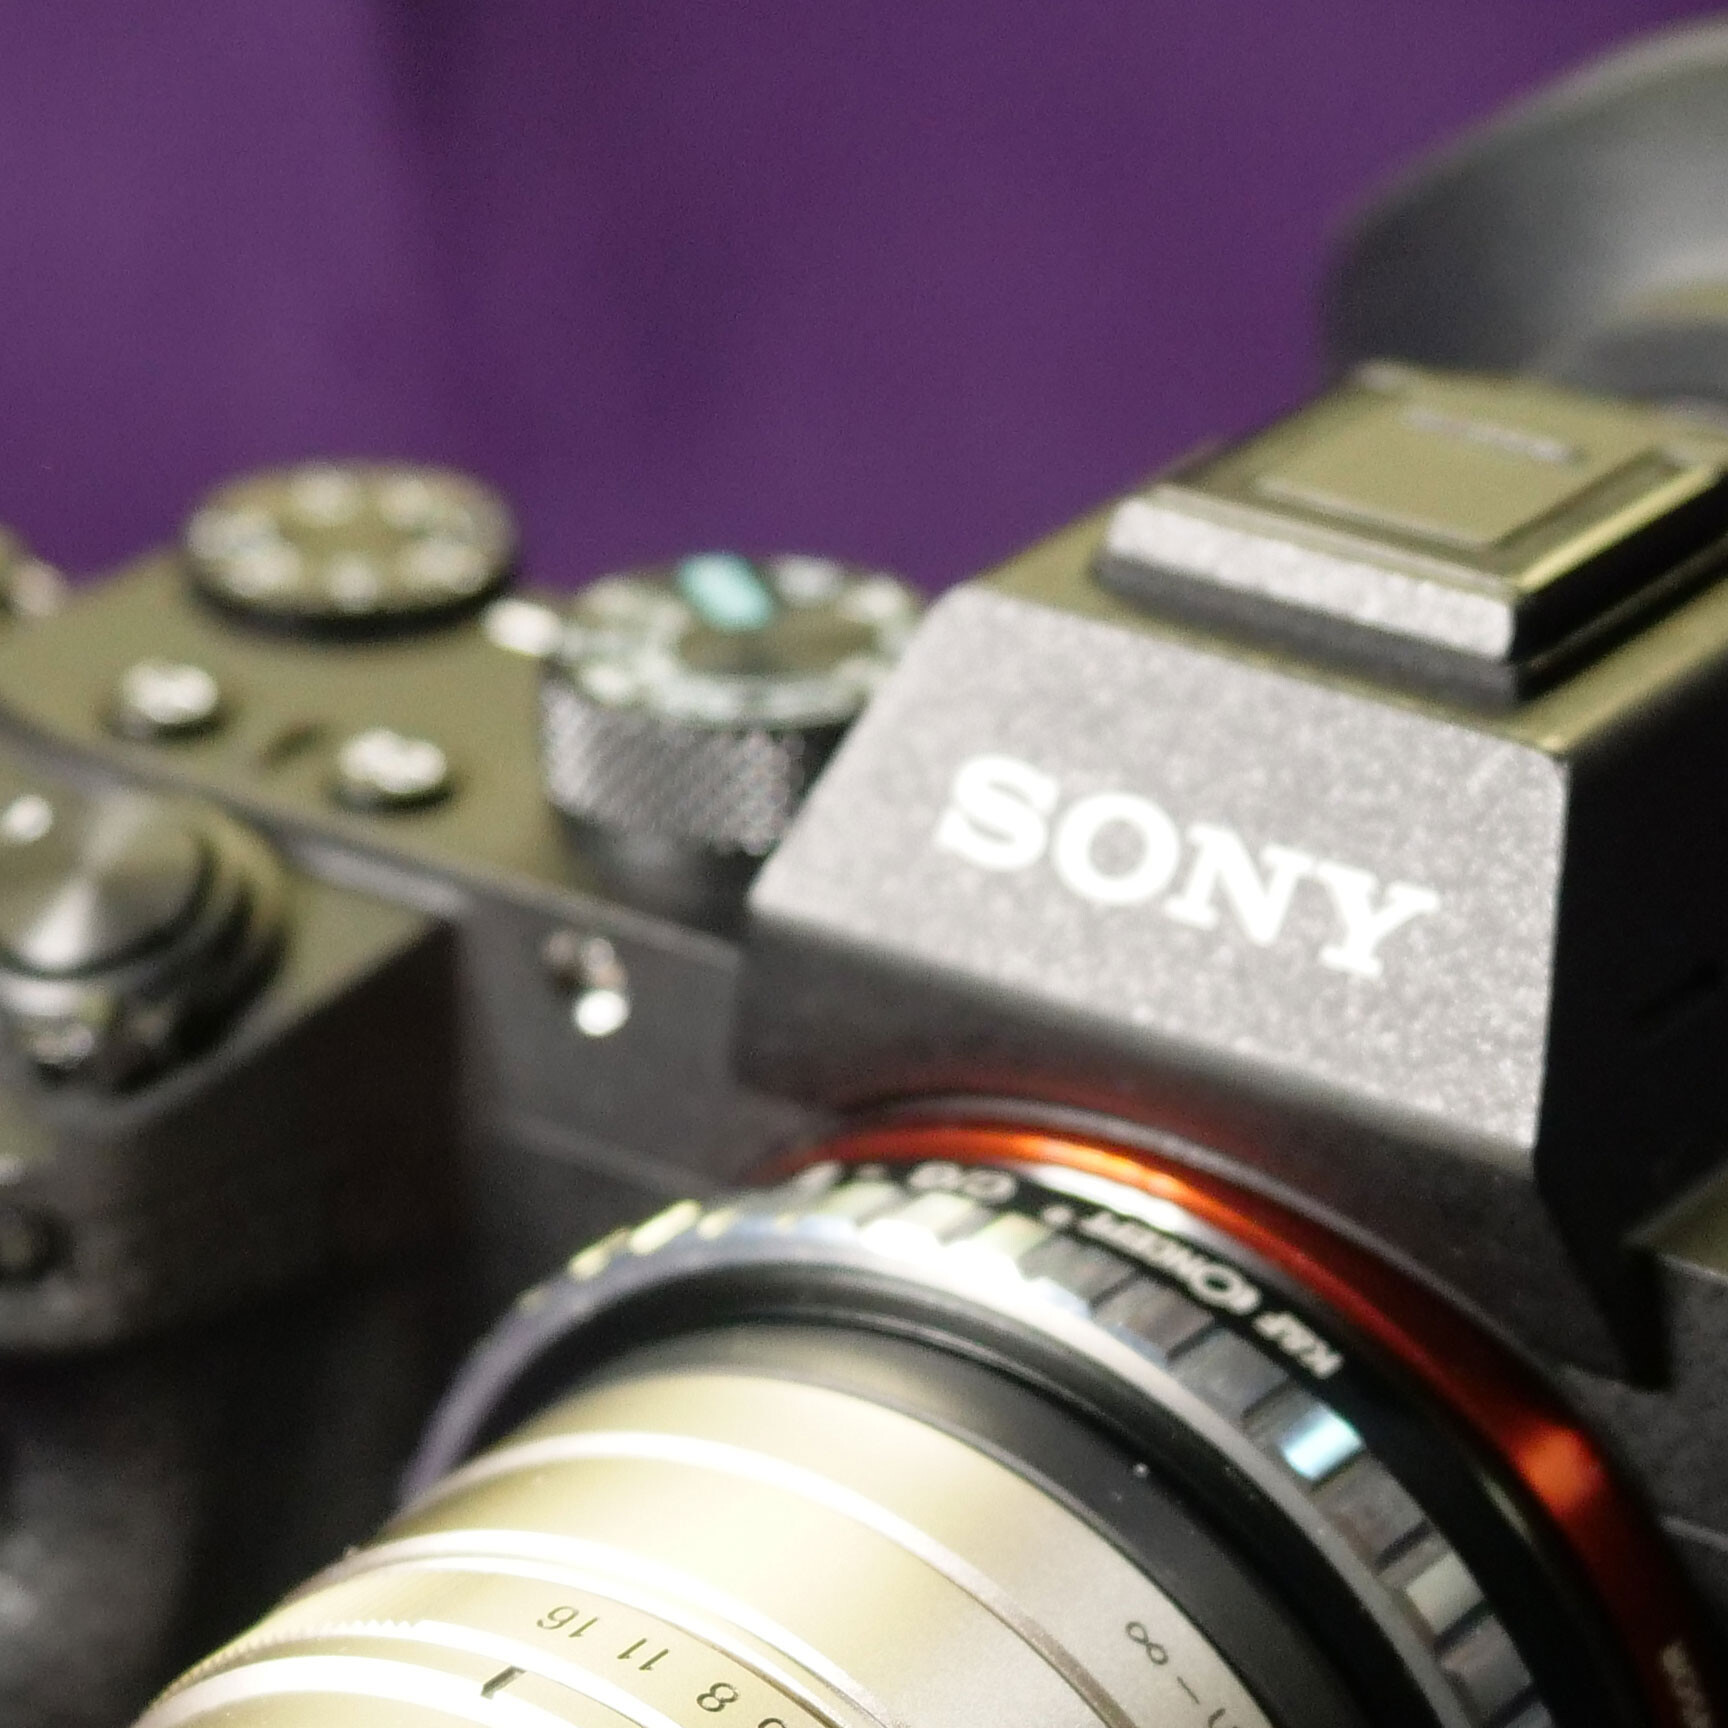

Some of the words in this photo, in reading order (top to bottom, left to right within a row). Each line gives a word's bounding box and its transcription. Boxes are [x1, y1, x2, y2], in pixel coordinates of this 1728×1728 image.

[935, 752, 1439, 978] SONY
[536, 1606, 599, 1638] 16
[617, 1638, 669, 1671] 11
[696, 1682, 740, 1713] 8
